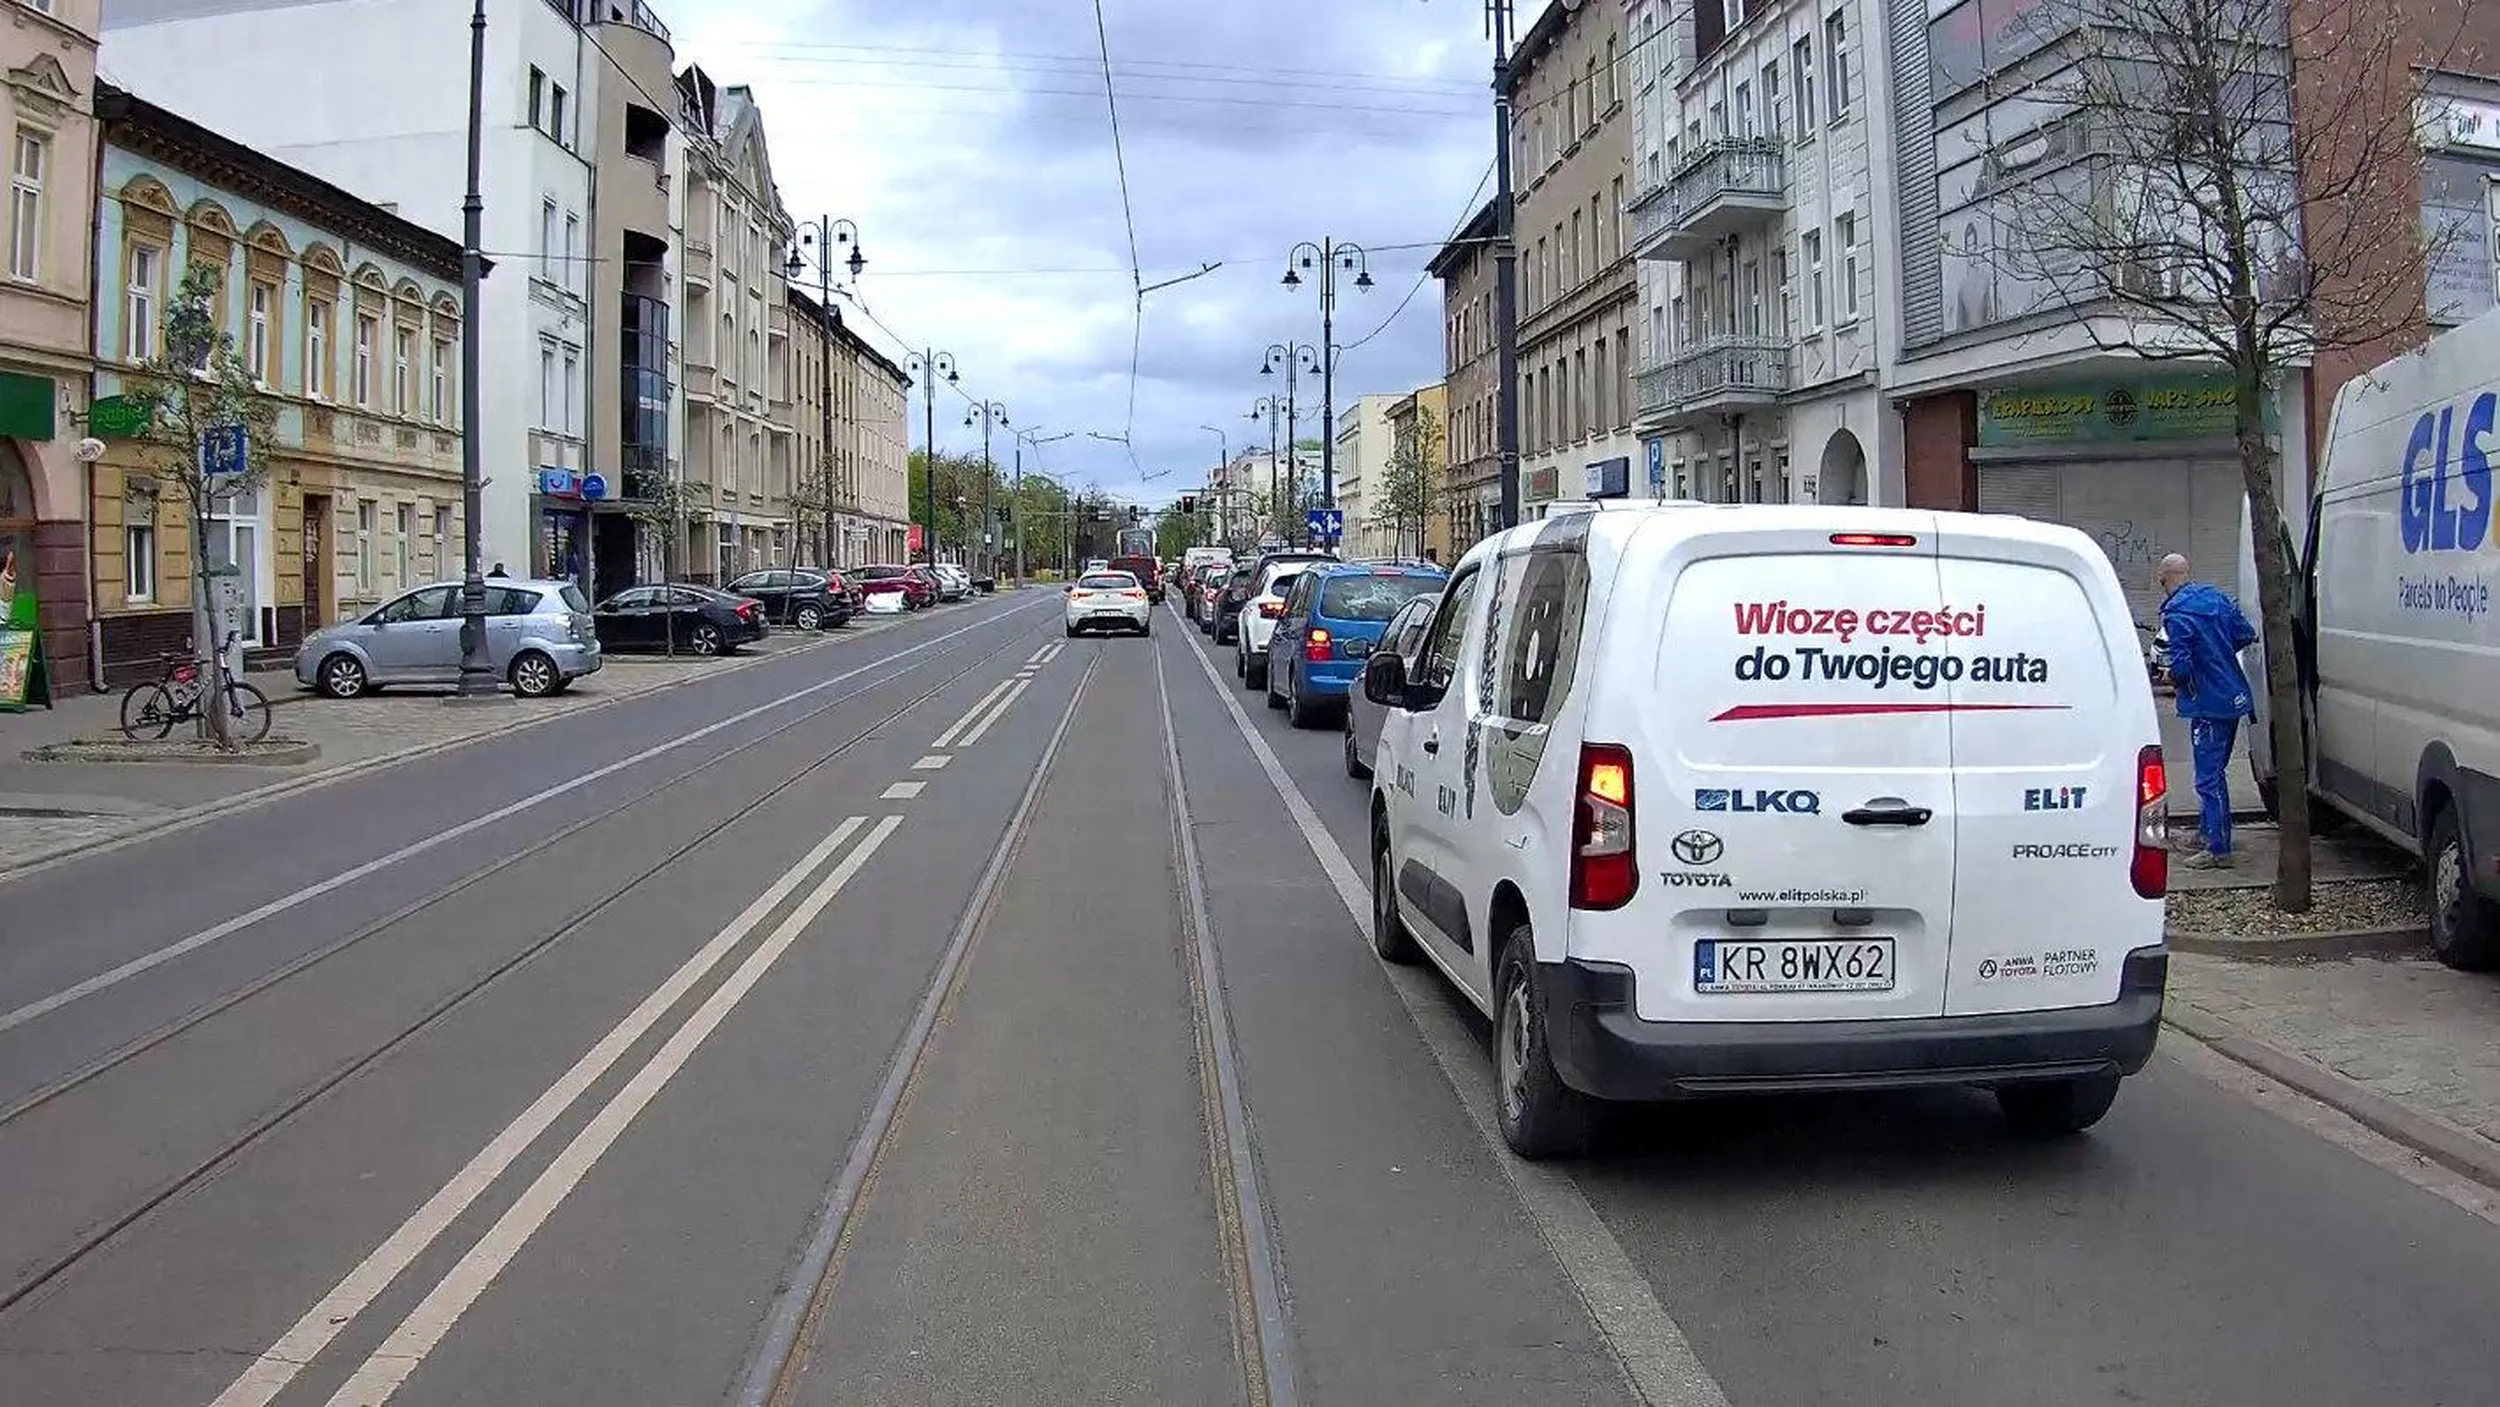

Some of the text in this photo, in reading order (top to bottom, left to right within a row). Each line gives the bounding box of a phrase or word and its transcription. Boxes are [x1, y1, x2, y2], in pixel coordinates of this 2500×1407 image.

[2401, 392, 2497, 554] GLS
[2400, 572, 2488, 623] Parcels to People
[1734, 600, 1986, 645] Wiozę części
[1735, 646, 2048, 690] do Twojego auta
[1731, 788, 1821, 815] LKQ
[2013, 843, 2118, 859] PROACE CITY
[1660, 871, 1733, 888] TOYOTA
[1738, 888, 1865, 904] www.elitpolska.pl
[1722, 944, 1884, 980] KR 8WX62
[2004, 956, 2035, 967] ANWA
[2044, 949, 2097, 964] PARTNER
[1700, 968, 1713, 978] PL
[2000, 966, 2038, 978] TOYOTA
[2043, 962, 2099, 977] FLOTOWY
